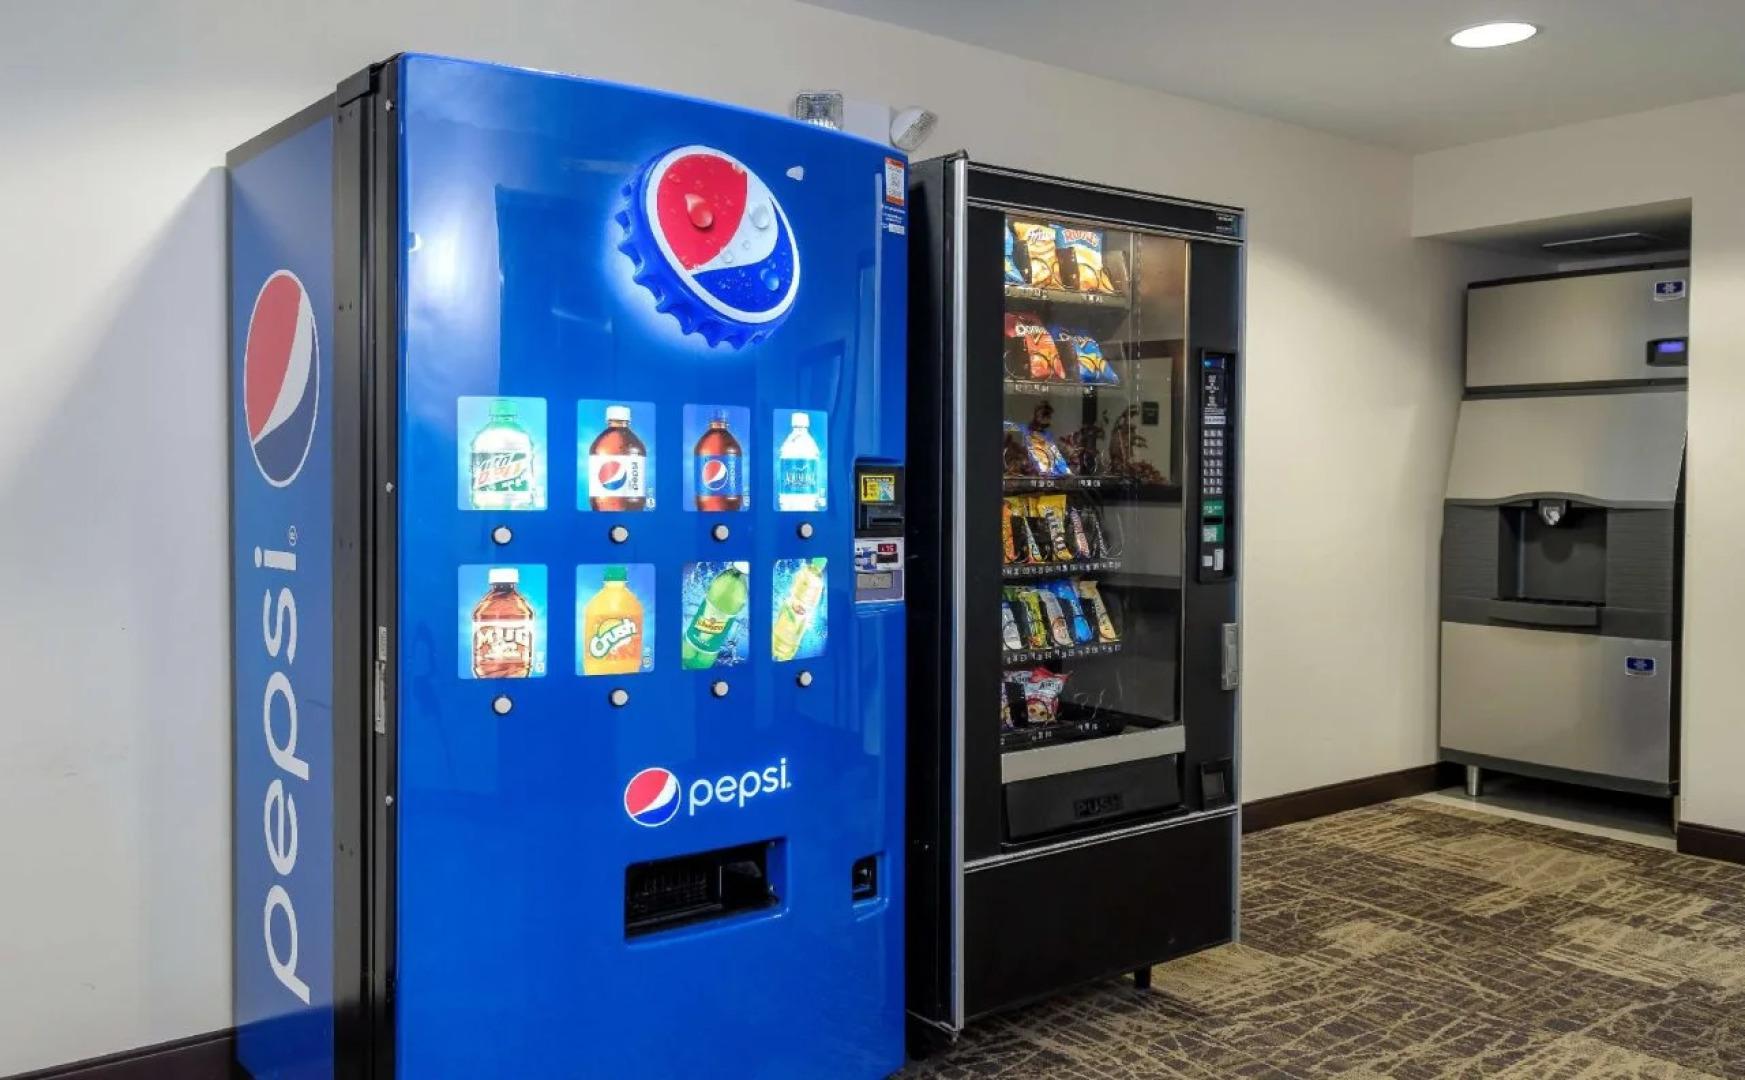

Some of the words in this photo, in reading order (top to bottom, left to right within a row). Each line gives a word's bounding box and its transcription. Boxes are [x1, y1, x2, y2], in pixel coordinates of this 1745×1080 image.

[589, 617, 637, 659] Crush
[254, 545, 310, 1006] pepsi
[689, 757, 788, 817] pepsi
